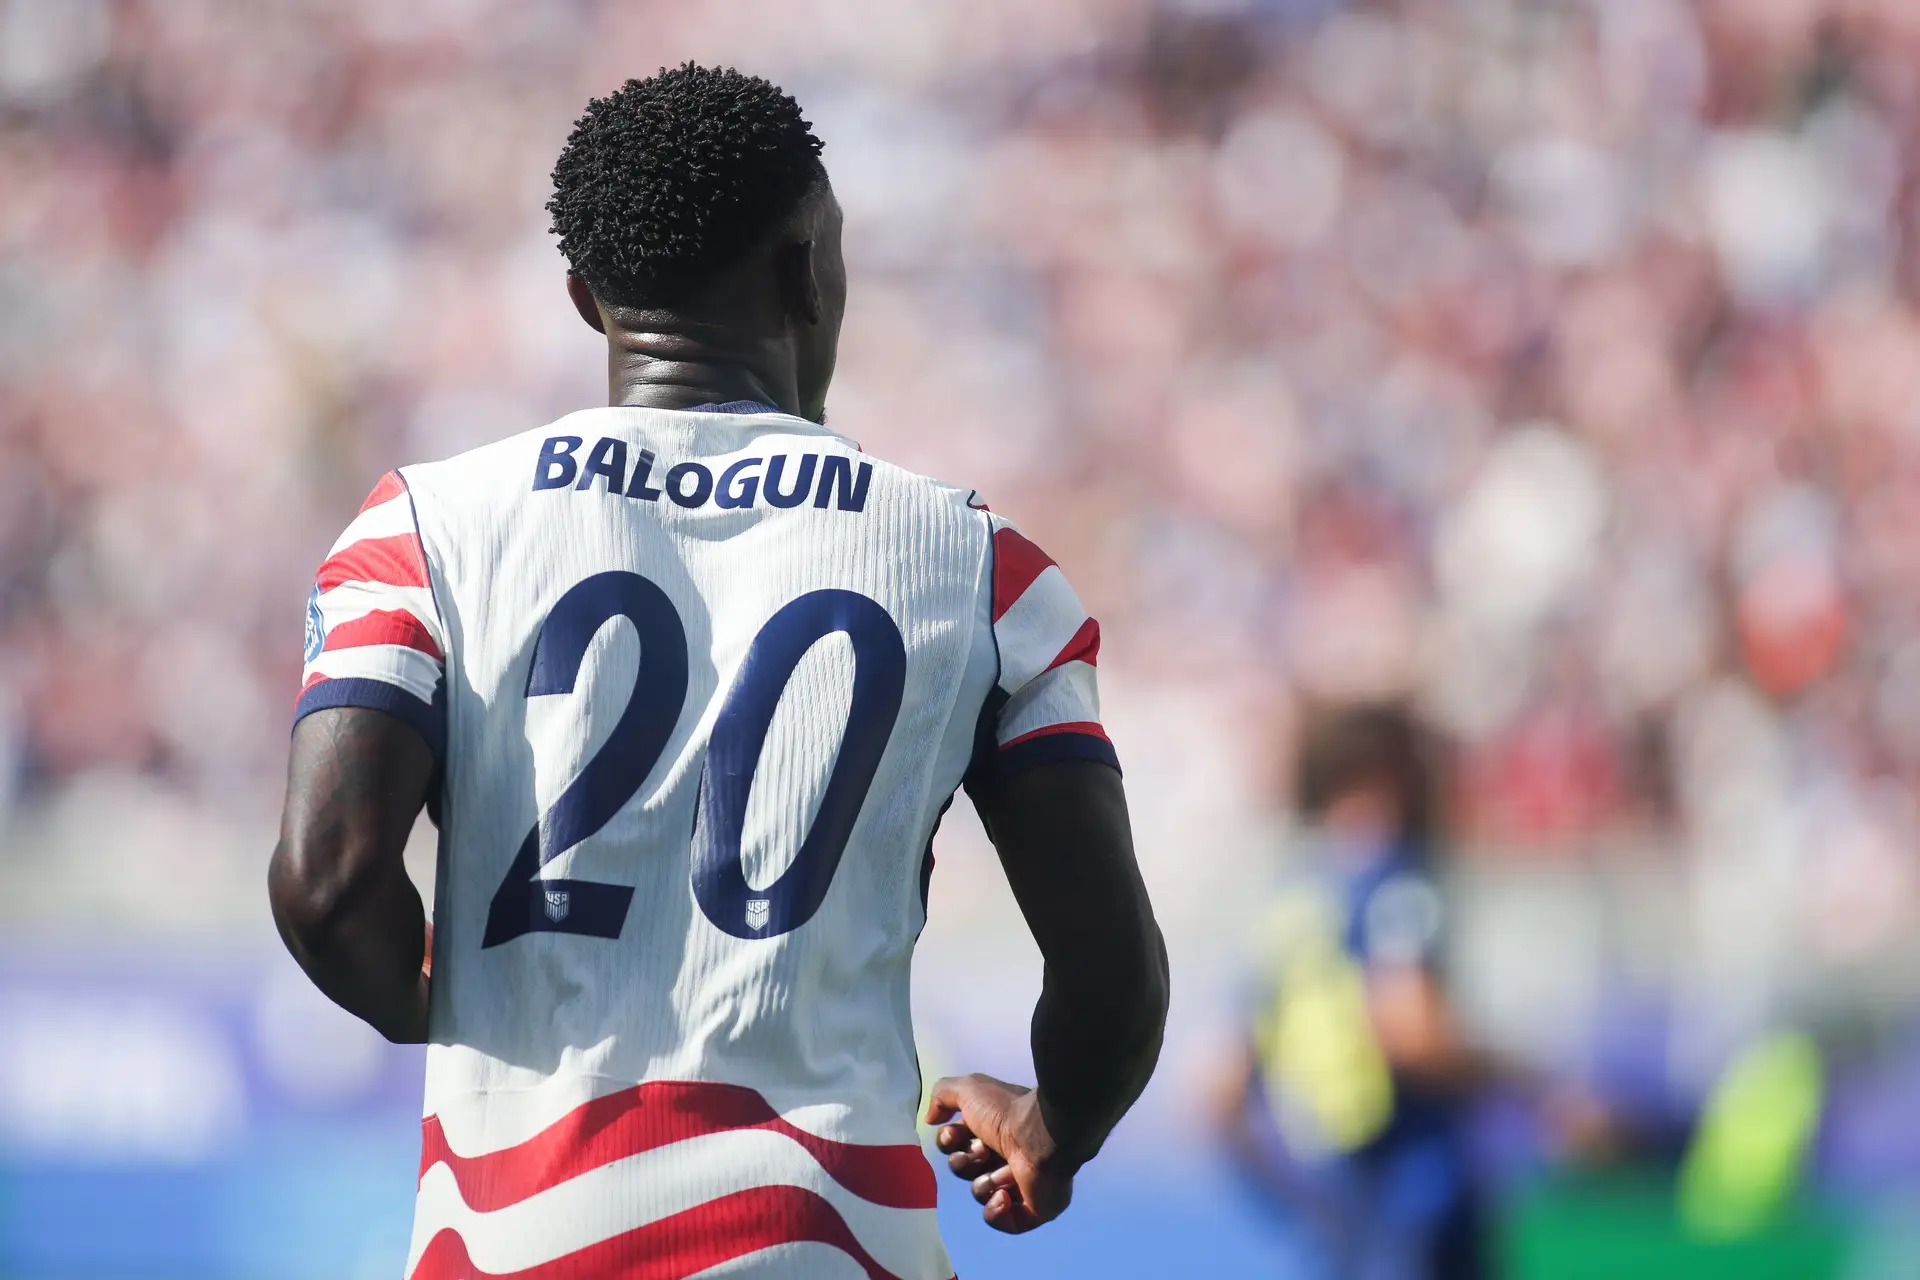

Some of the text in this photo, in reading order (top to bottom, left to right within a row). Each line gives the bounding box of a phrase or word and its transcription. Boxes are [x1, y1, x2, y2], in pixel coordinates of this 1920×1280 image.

[532, 435, 873, 513] BALOGUN
[481, 570, 907, 950] 20
[547, 893, 568, 906] USA
[747, 901, 768, 914] USA
